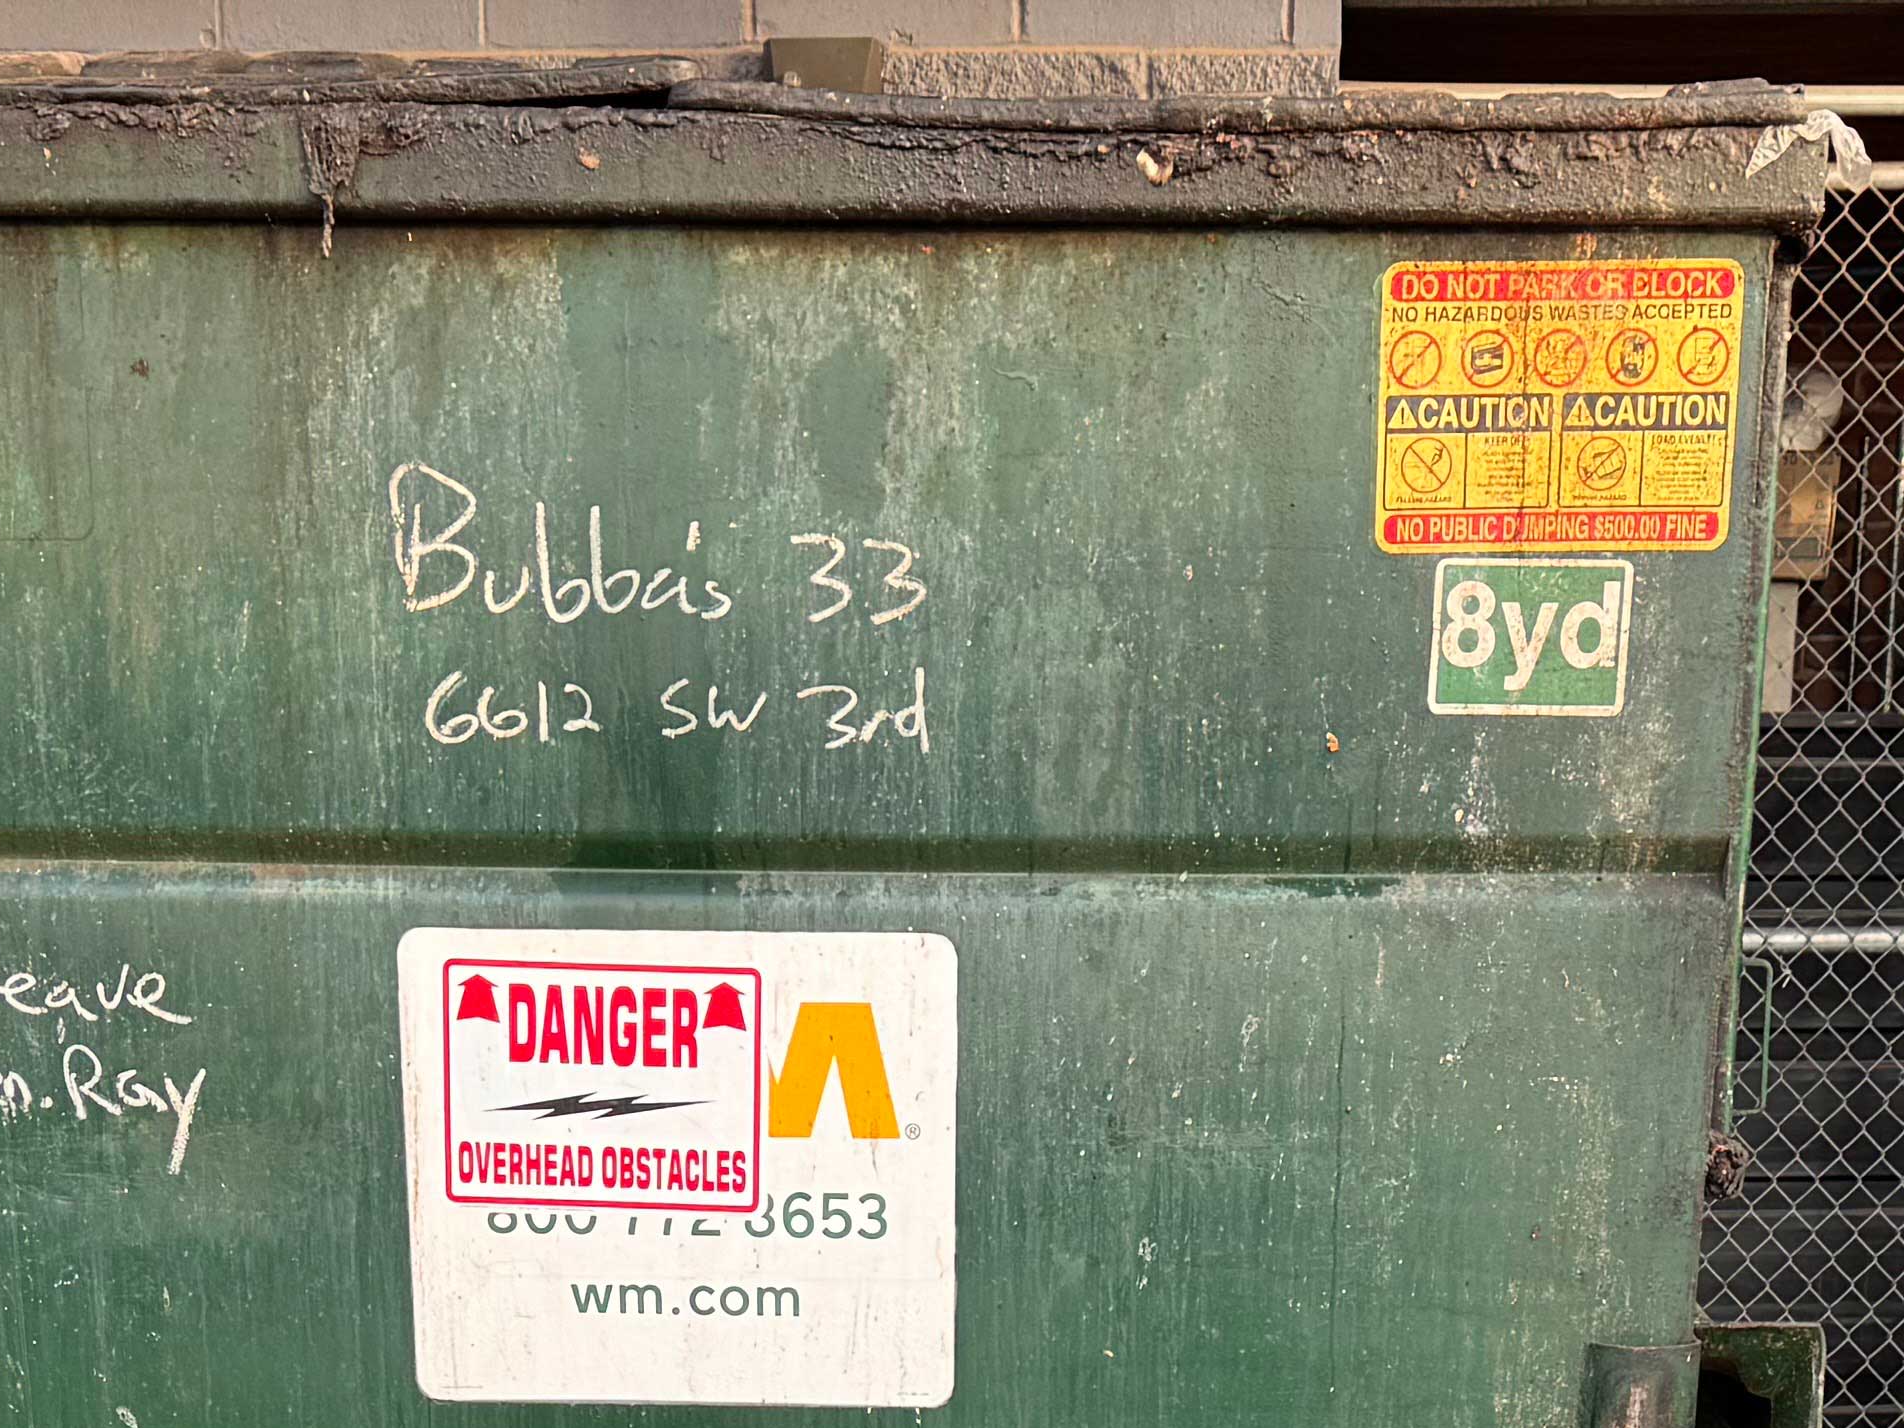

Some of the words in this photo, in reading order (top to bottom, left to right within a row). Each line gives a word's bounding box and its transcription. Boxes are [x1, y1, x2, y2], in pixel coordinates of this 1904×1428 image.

[1400, 274, 1439, 300] DO
[1446, 273, 1501, 300] NOT
[1507, 272, 1576, 299] PARK
[1585, 272, 1626, 299] OR
[1632, 271, 1724, 298] BLOCK
[1392, 306, 1418, 322] NO
[1424, 305, 1544, 322] HAZARDOUS
[1549, 304, 1628, 321] WASTES
[1417, 395, 1551, 428] CAUTION
[1594, 394, 1726, 427] CAUTION
[388, 461, 733, 625] Bubba's
[790, 532, 928, 626] 33
[1395, 516, 1424, 542] NO
[1429, 516, 1498, 542] PUBLIC
[1502, 515, 1590, 541] DUMPING
[1666, 514, 1707, 539] FINE
[1440, 580, 1622, 691] 8yd
[424, 670, 601, 744] 6612
[796, 665, 930, 754] 3rd
[507, 982, 699, 1069] DANGER
[62, 1043, 207, 1176] Ray
[457, 1140, 594, 1187] OVERHEAD
[600, 1143, 747, 1193] OBSTACLES
[571, 1282, 800, 1317] wm.com
